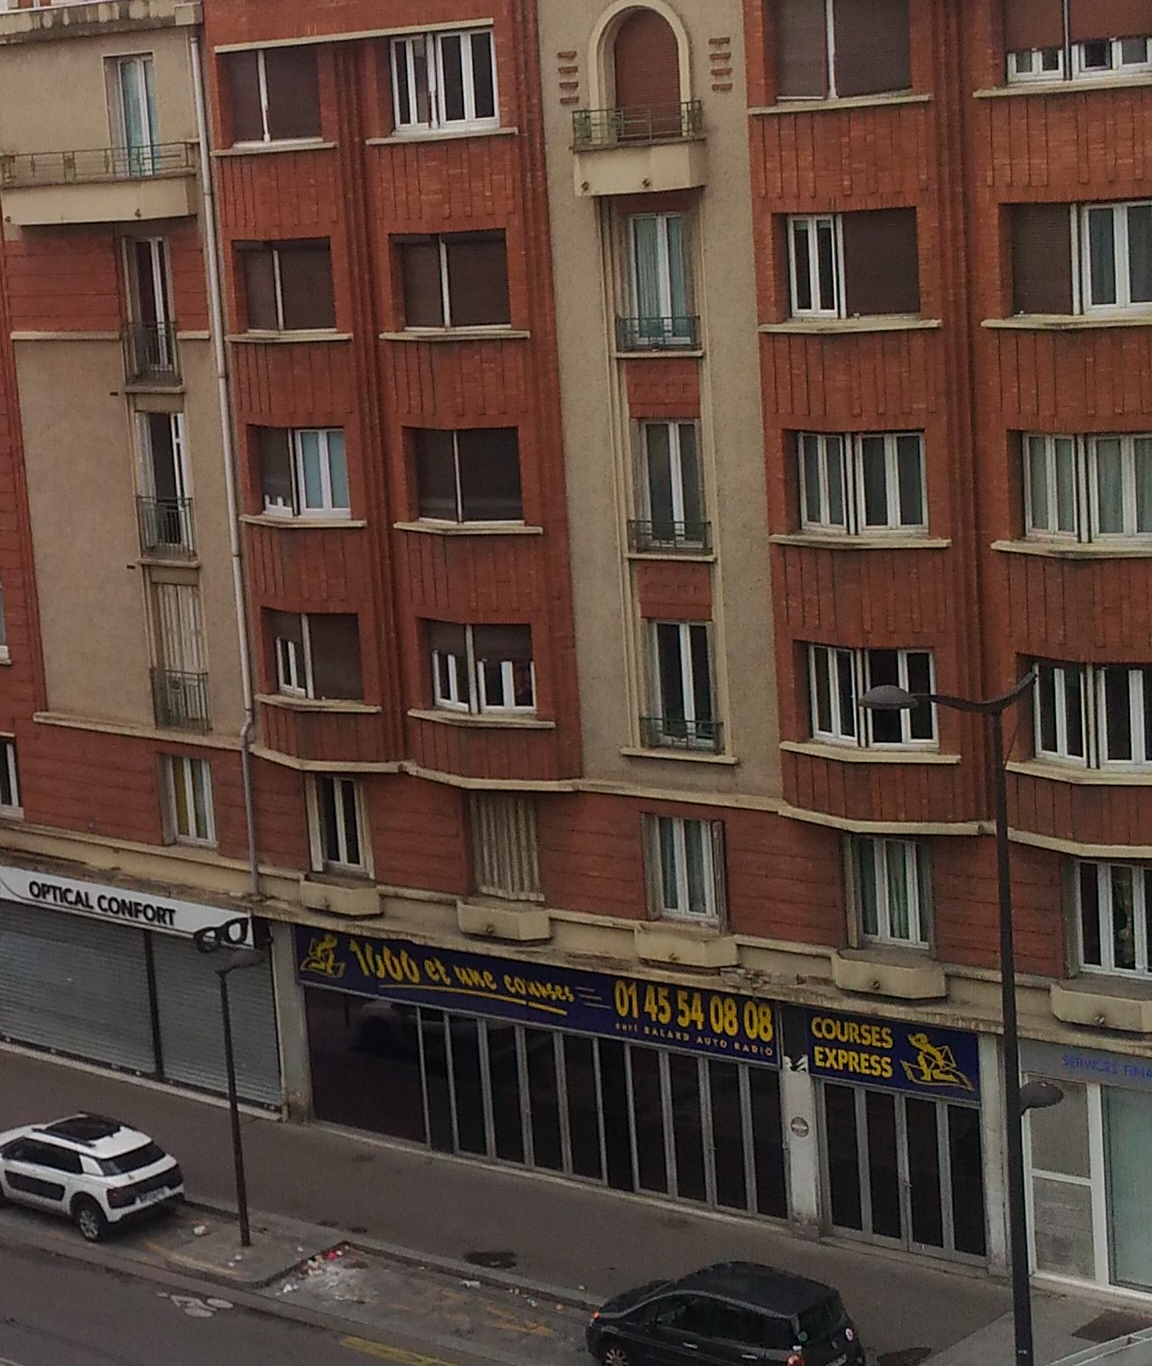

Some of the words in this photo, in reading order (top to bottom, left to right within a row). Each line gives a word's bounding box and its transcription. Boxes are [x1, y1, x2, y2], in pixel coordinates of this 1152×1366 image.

[28, 880, 94, 910] OPTICAL
[97, 894, 176, 926] CONFORT
[424, 956, 451, 986] et
[452, 964, 498, 991] une
[503, 973, 576, 1003] courses
[614, 979, 639, 1019] 01
[644, 985, 671, 1024] 45
[677, 990, 704, 1030] 54
[709, 995, 739, 1036] 08
[743, 1000, 773, 1042] 08
[643, 1026, 690, 1041] BALARD
[696, 1036, 727, 1049] AUTO
[734, 1043, 773, 1056] RADIO
[811, 1016, 894, 1049] COURSES
[814, 1045, 894, 1078] EXPRESS
